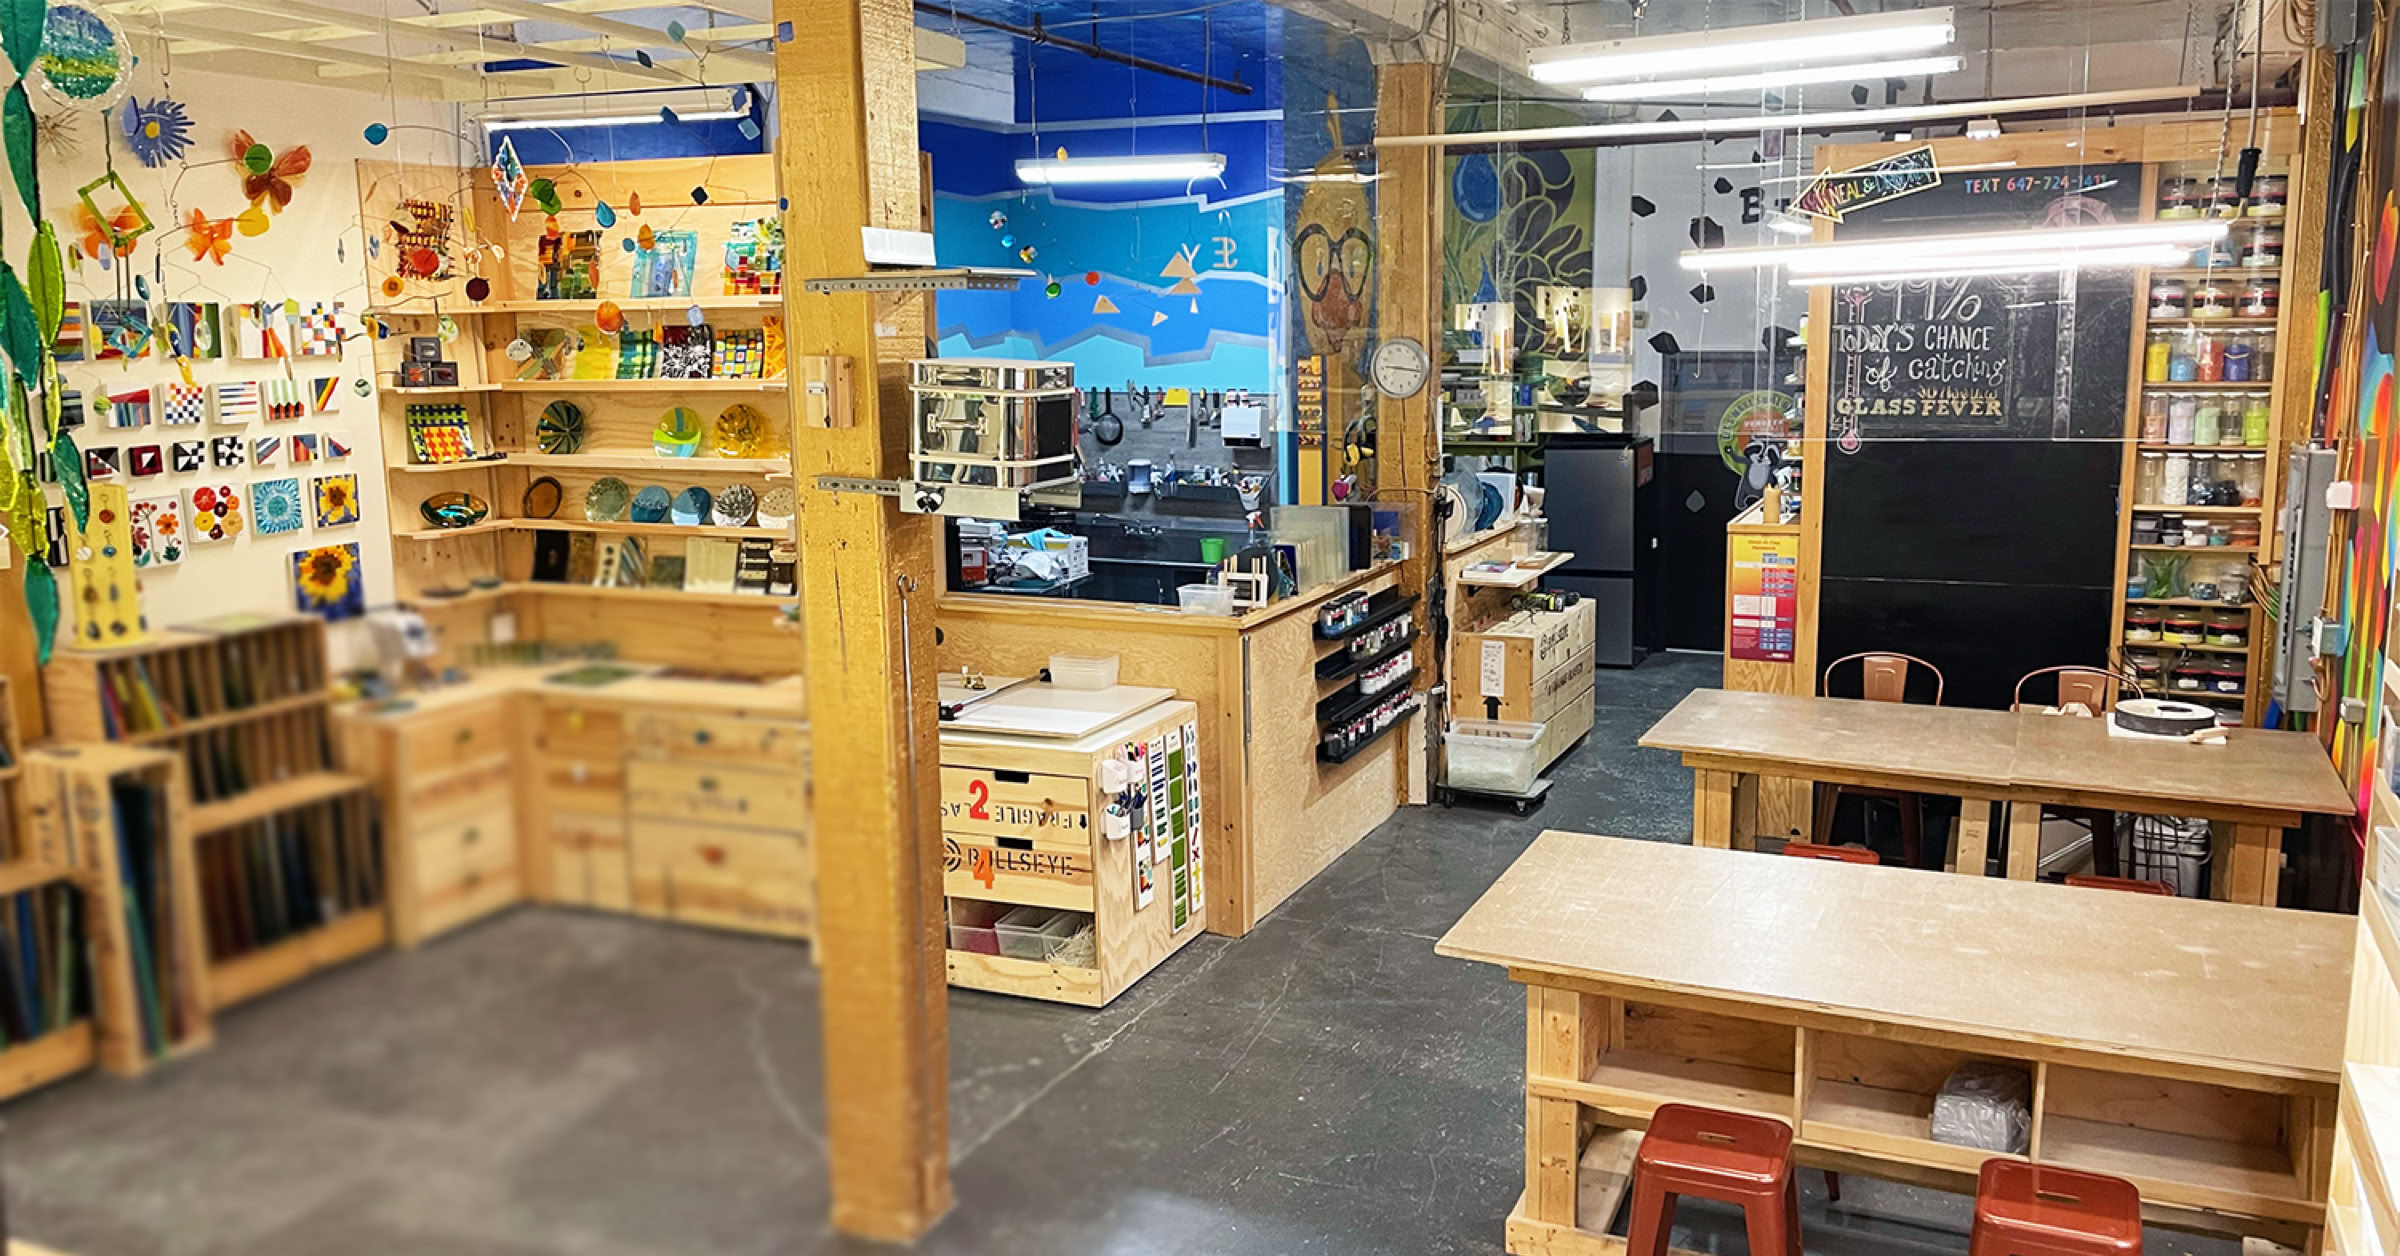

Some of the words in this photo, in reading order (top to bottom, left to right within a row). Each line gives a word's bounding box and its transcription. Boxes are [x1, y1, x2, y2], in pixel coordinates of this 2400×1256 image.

[1964, 178, 2000, 194] TEXT
[1924, 325, 1994, 351] CHANCE
[1865, 356, 1898, 392] of
[1909, 352, 2006, 386] catching
[1836, 398, 1916, 415] GLASS
[1921, 399, 2002, 417] FEVER
[969, 779, 989, 820] 2
[994, 805, 1073, 829] FRAGILE
[973, 848, 995, 889] 4
